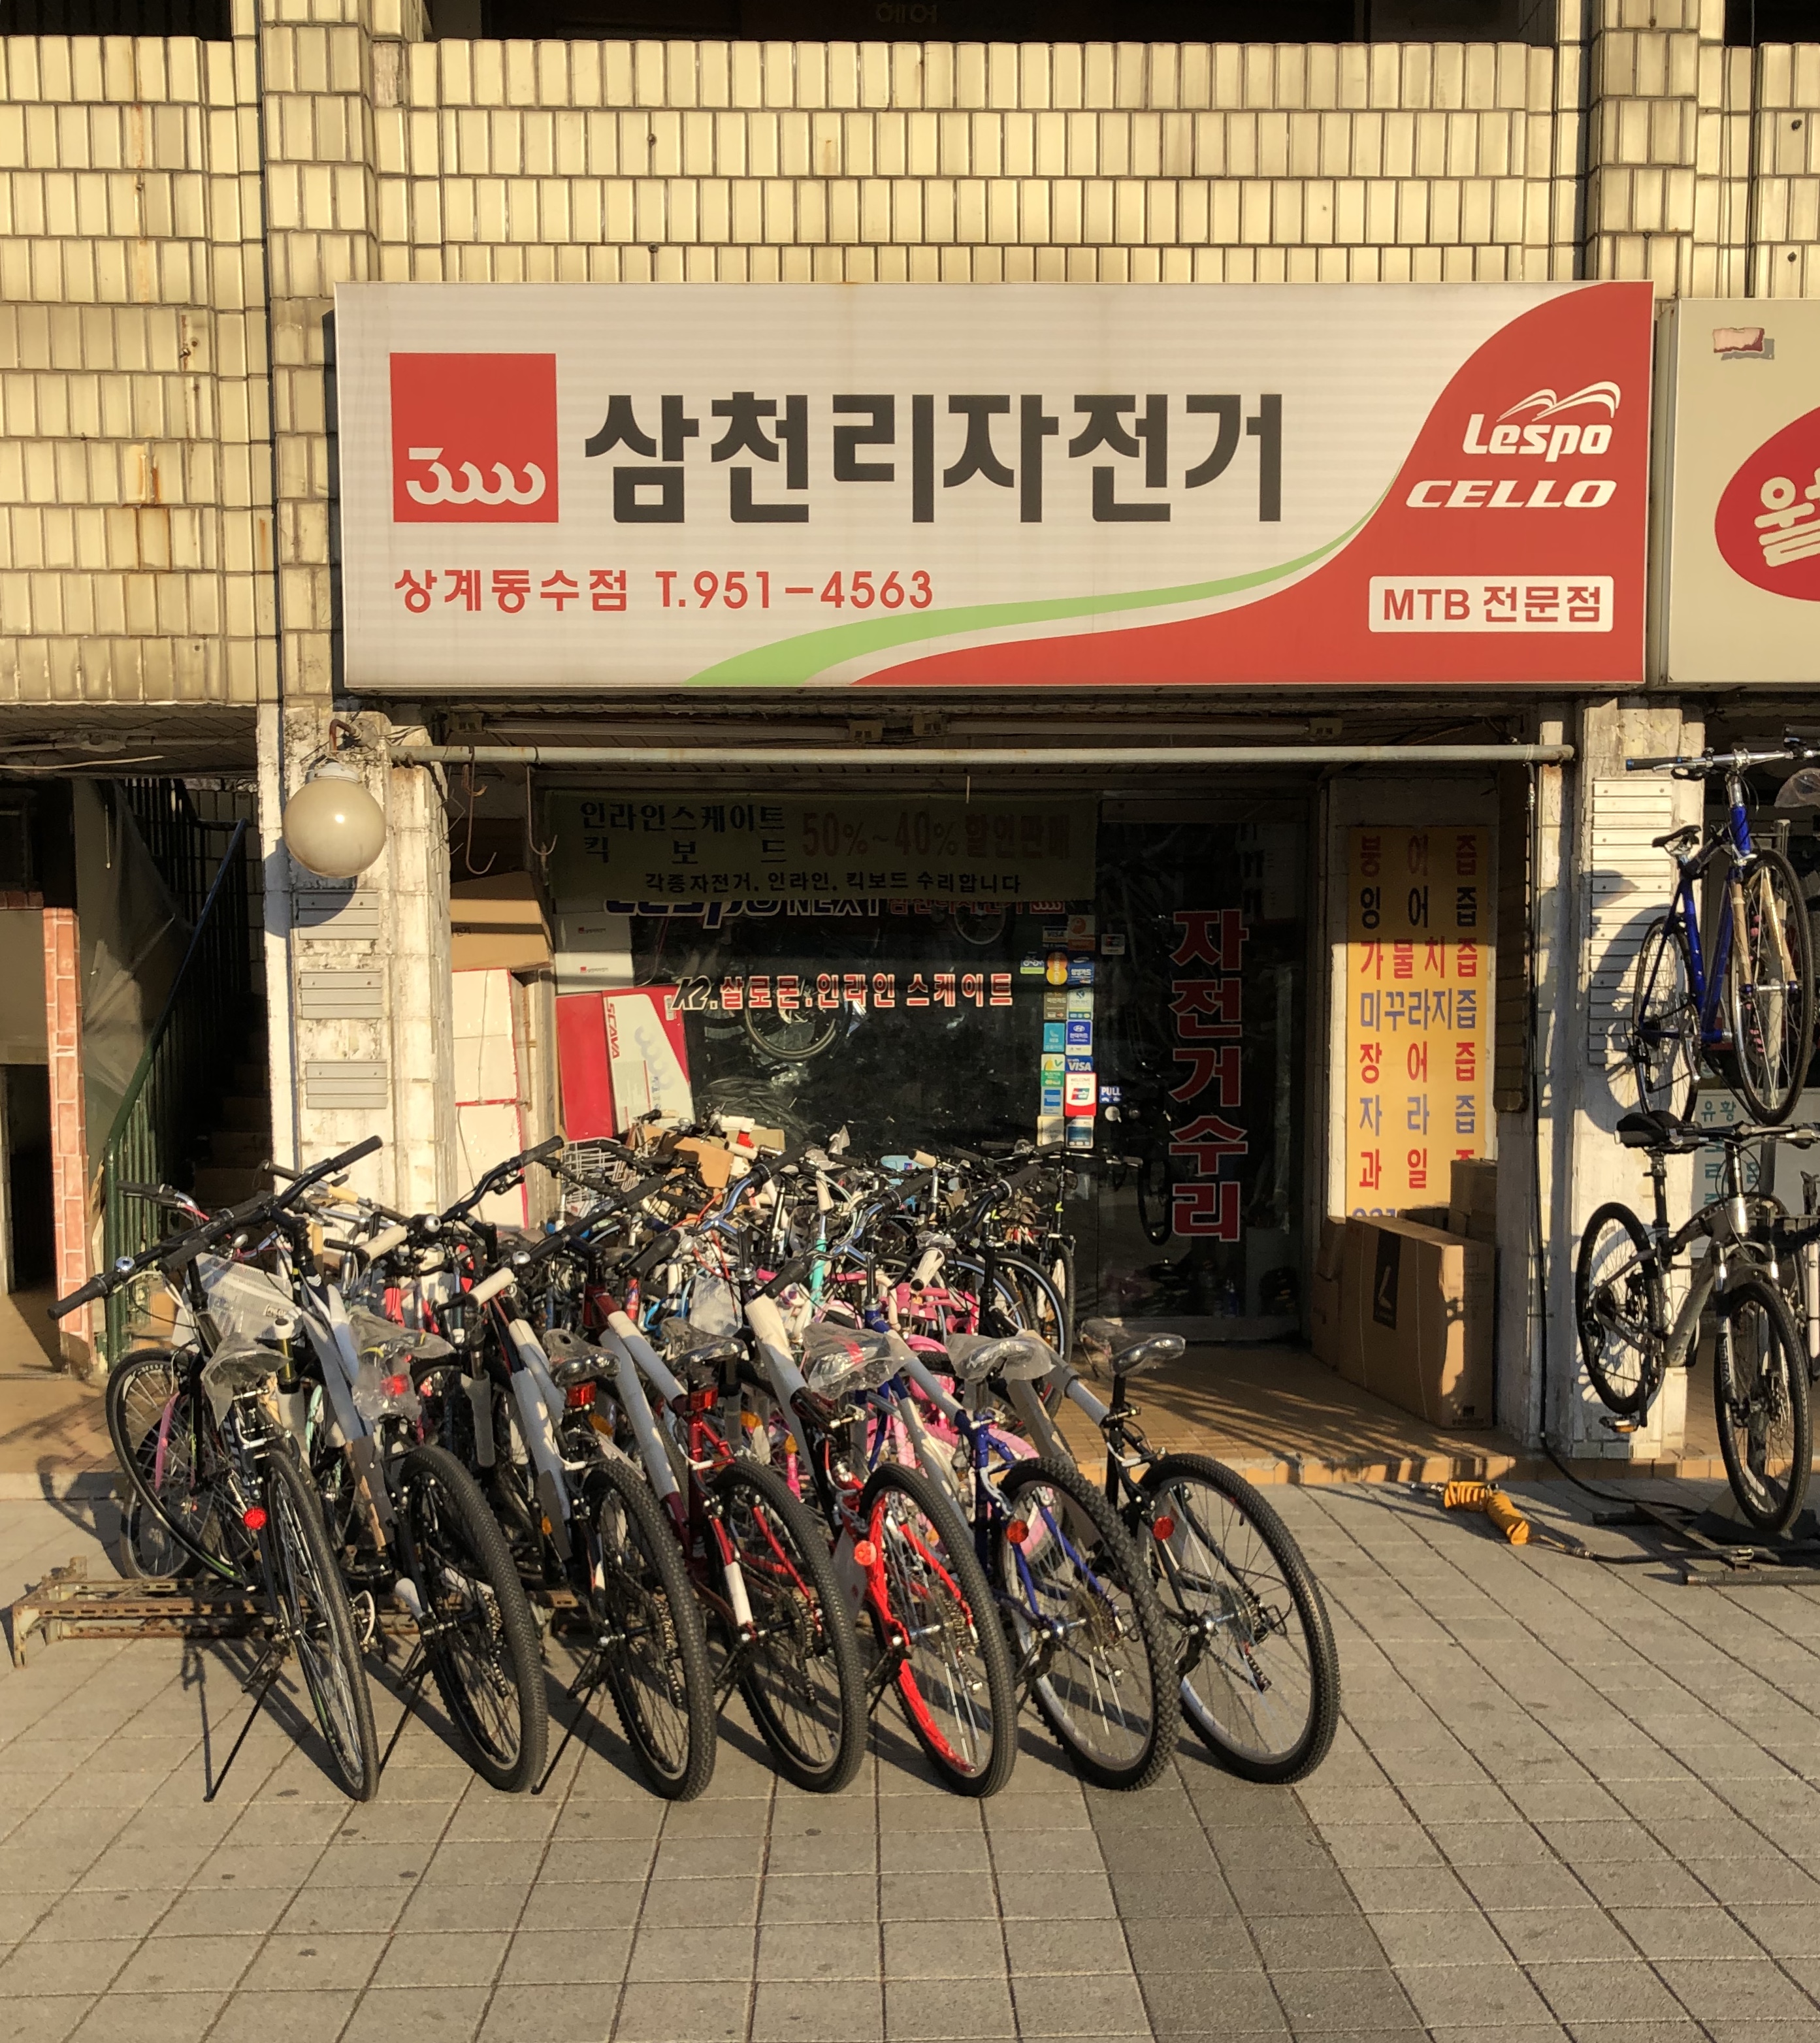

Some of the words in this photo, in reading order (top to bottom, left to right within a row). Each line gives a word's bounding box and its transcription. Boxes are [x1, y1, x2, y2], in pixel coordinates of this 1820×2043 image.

[1462, 413, 1614, 462] Lespo
[585, 392, 1282, 523] 삼천리자전거
[1406, 479, 1617, 508] CELLO
[393, 568, 628, 614] 상계동수점
[1383, 588, 1471, 621] MTB
[1482, 586, 1601, 623] 전문점
[580, 802, 786, 833] 인라인스케이트
[847, 871, 909, 890] 킥보드
[917, 871, 1021, 893] 수리합니다
[906, 972, 1014, 1009] 스케이트
[1359, 988, 1477, 1032] 미꾸라지즙
[1068, 1061, 1092, 1071] VISA
[1101, 1087, 1122, 1096] PULL
